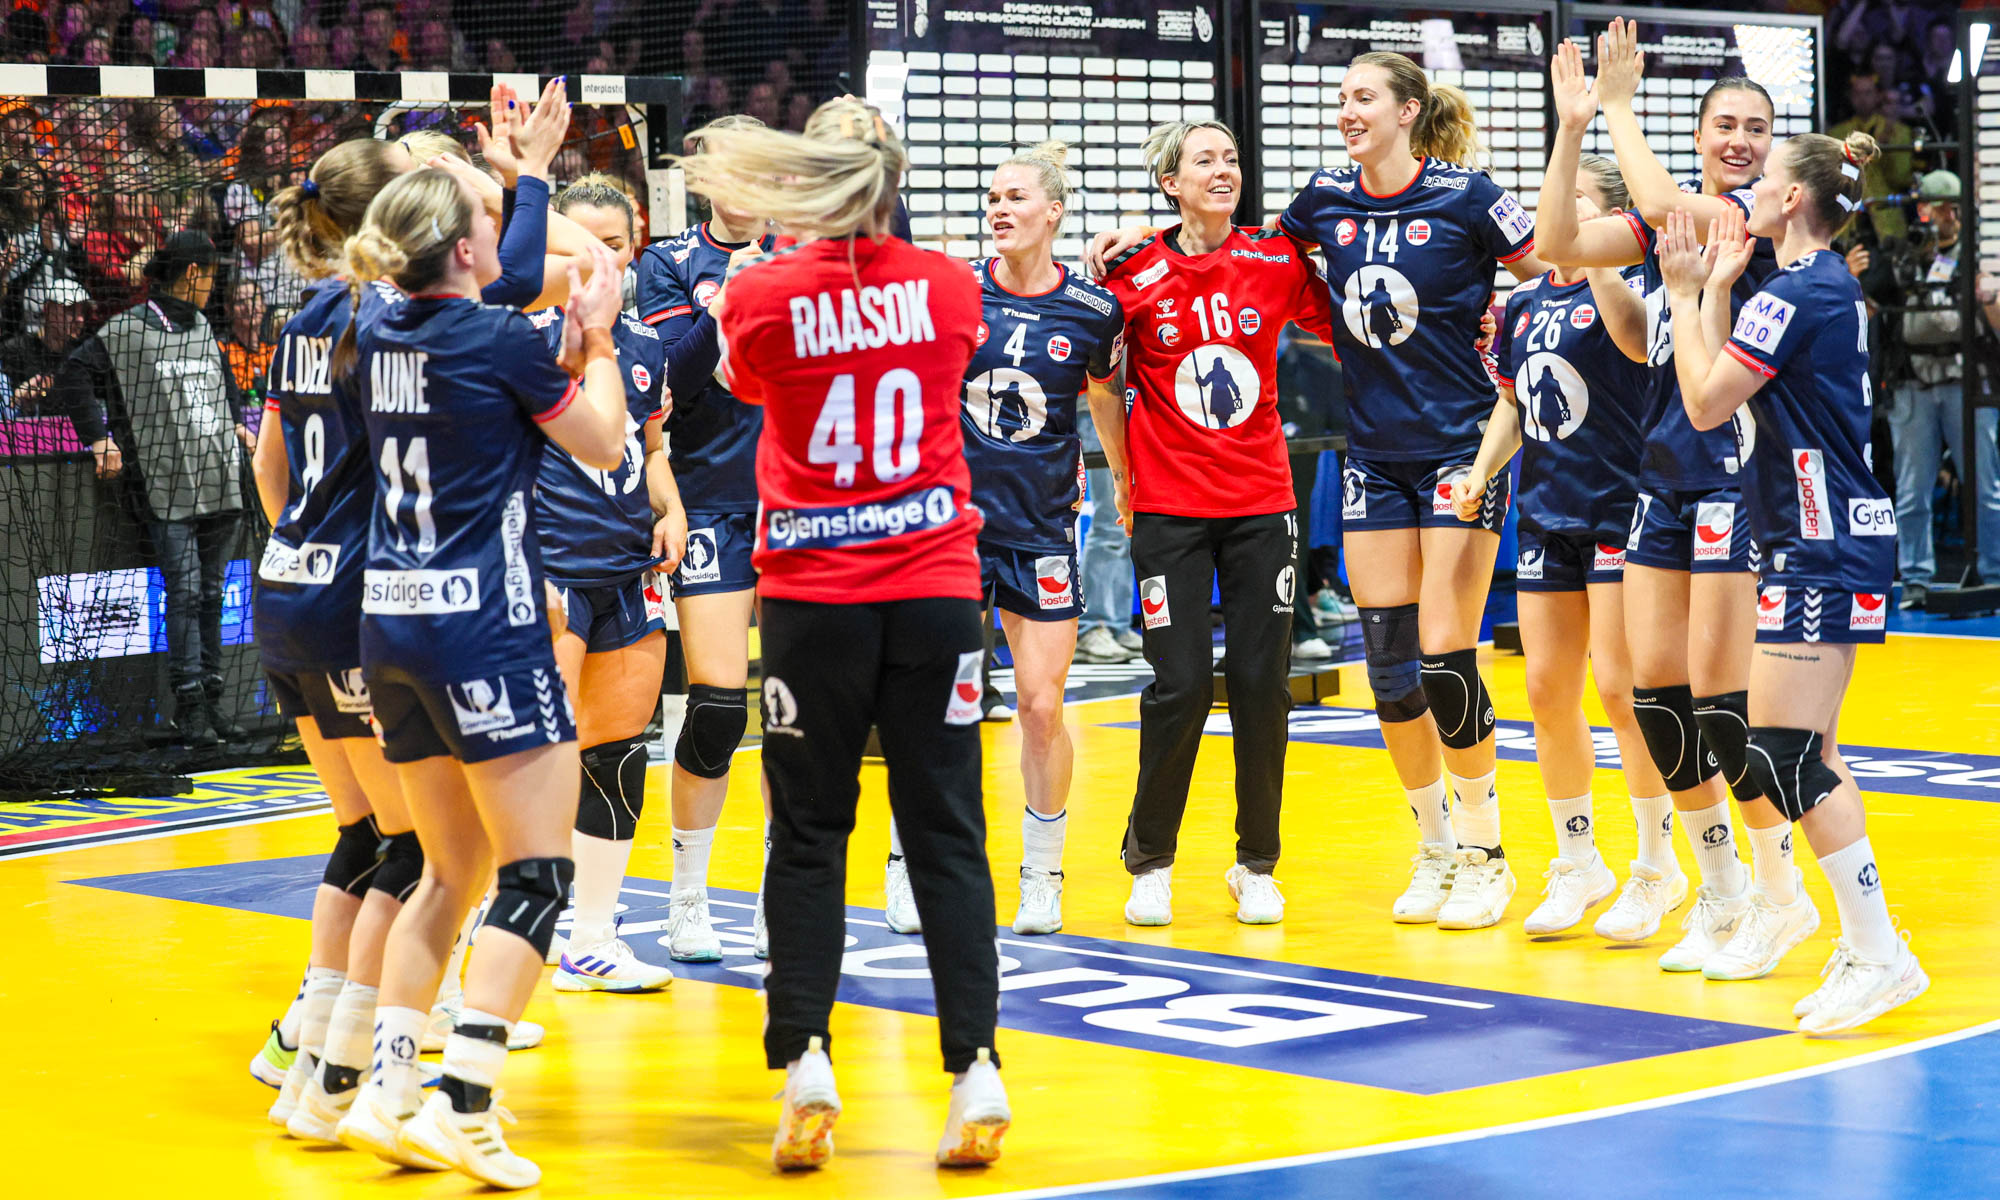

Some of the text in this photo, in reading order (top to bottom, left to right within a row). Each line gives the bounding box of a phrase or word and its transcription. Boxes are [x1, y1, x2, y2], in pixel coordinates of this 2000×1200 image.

[584, 83, 623, 94] interplastic
[1230, 249, 1290, 264] GJENSIDIGE
[1363, 218, 1399, 263] 14
[789, 279, 936, 358] RAASOK
[1011, 309, 1040, 321] hummel
[1065, 285, 1113, 315] GJENSIDIGE
[1191, 292, 1233, 341] 16
[1003, 323, 1027, 367] 4
[1526, 308, 1566, 352] 26
[371, 352, 430, 413] AUNE
[807, 368, 924, 488] 40
[380, 437, 436, 553] 11
[1798, 477, 1820, 538] posten
[768, 499, 925, 547] Gjensidige
[1284, 514, 1298, 539] 16
[1695, 545, 1728, 556] posten
[1041, 595, 1073, 607] posten
